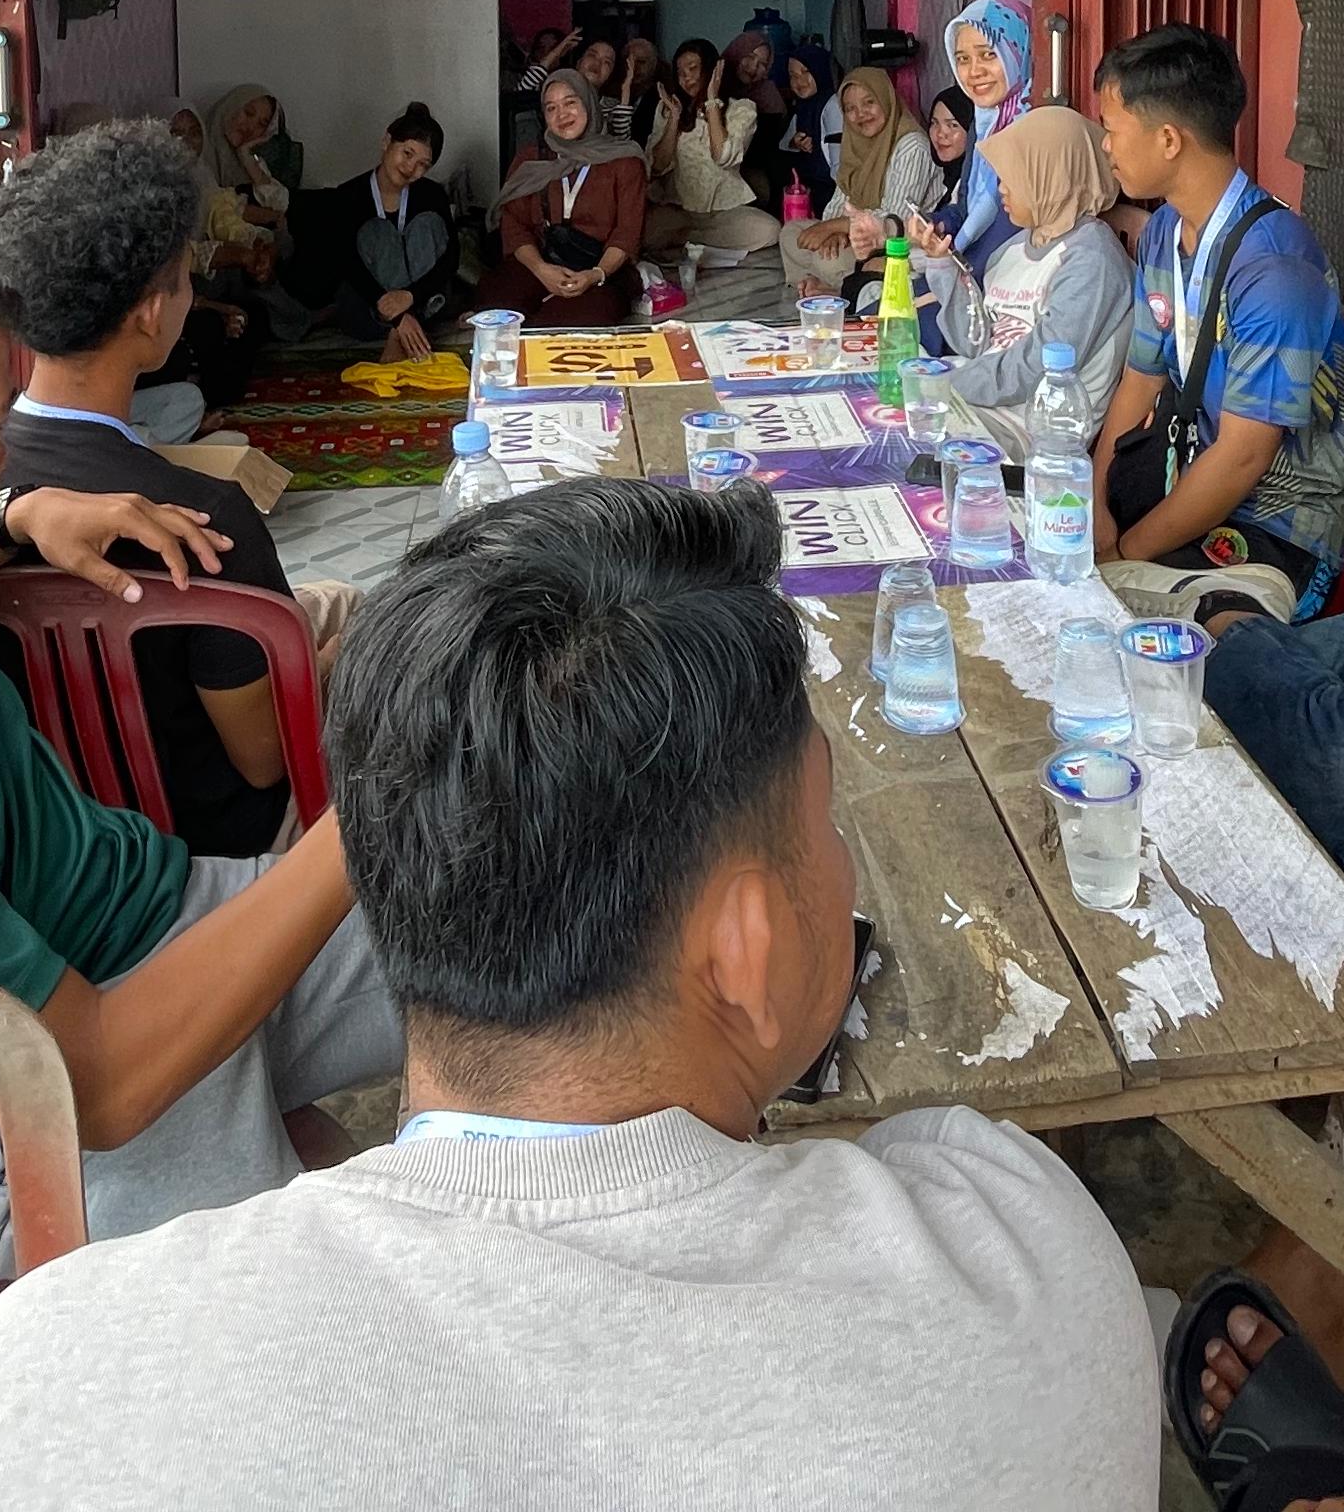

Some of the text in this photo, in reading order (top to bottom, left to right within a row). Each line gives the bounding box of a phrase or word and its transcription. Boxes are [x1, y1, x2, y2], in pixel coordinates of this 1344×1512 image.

[499, 410, 534, 455] WIN
[747, 402, 793, 445] WIN
[783, 498, 839, 557] WIN
[827, 502, 870, 547] CLICK
[1060, 513, 1074, 525] Le
